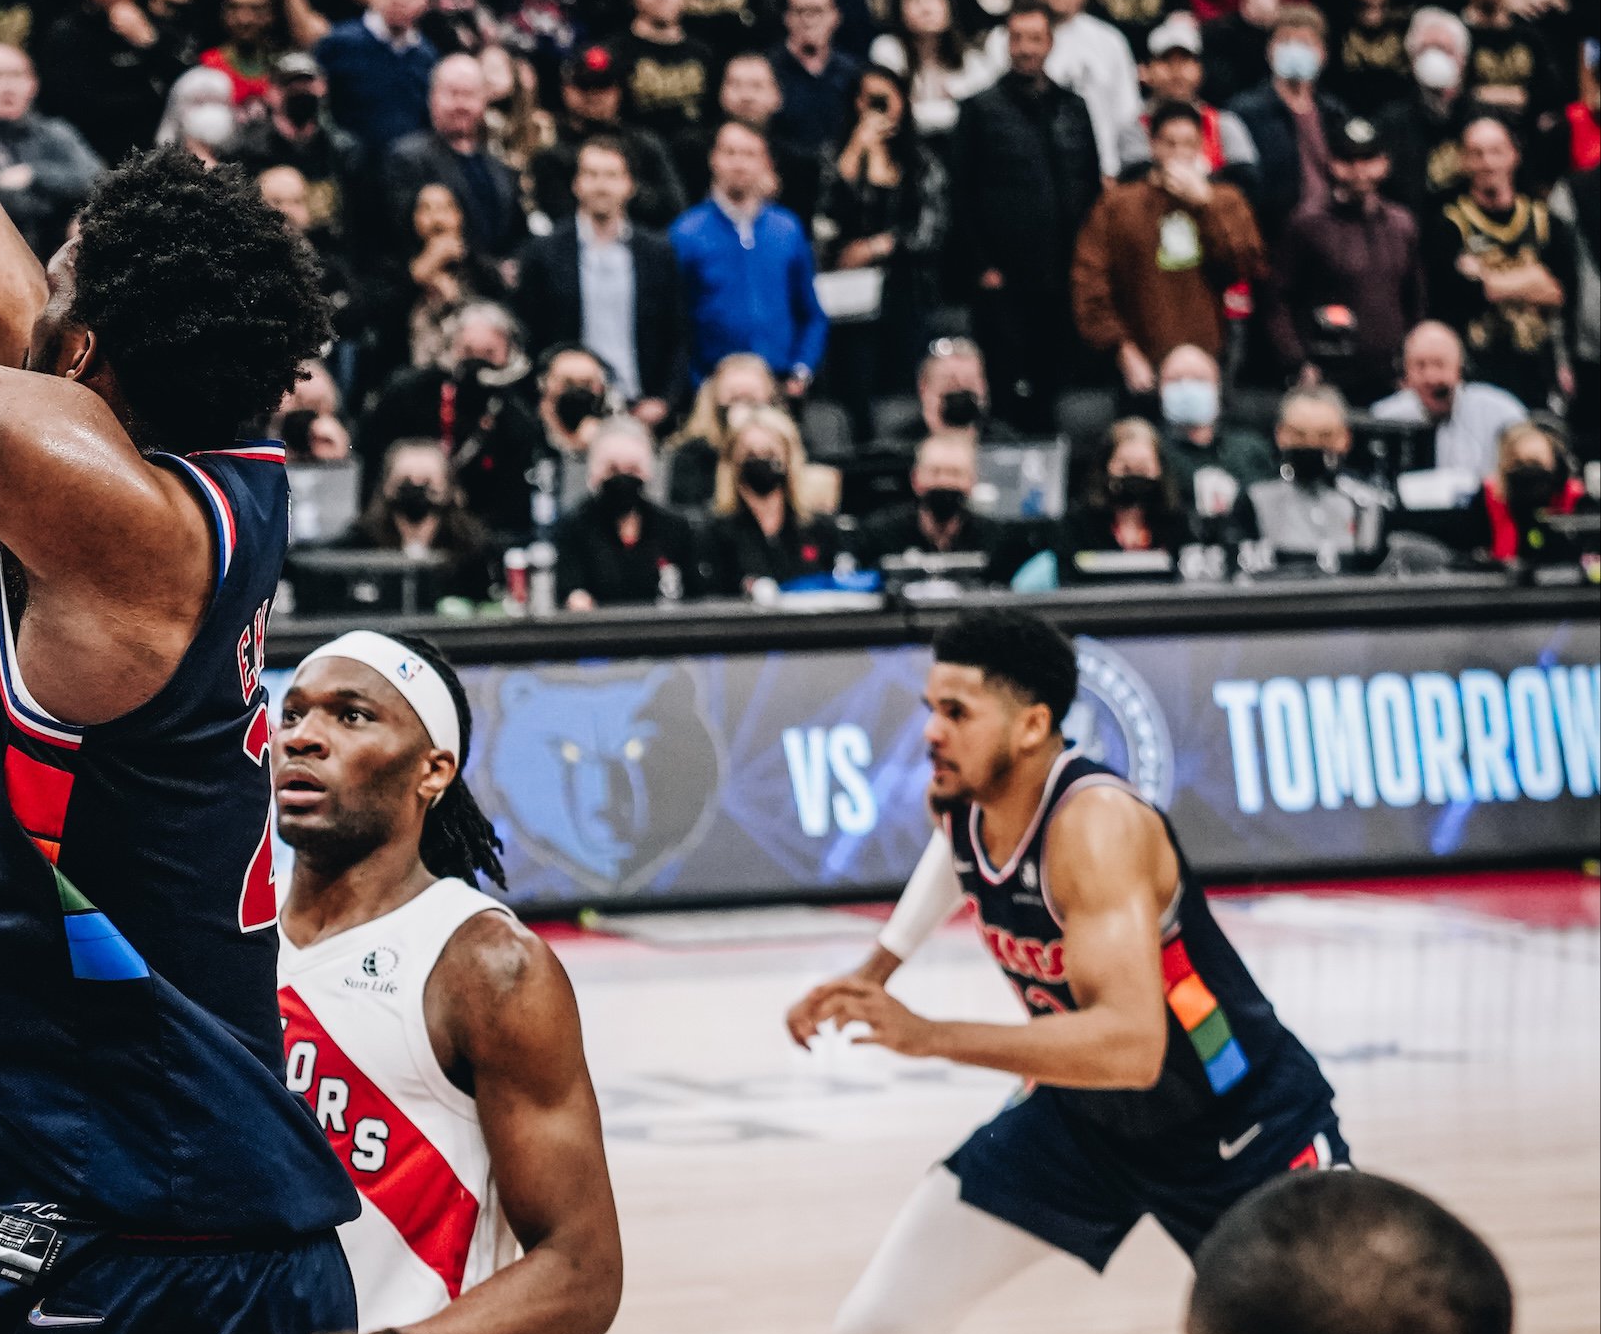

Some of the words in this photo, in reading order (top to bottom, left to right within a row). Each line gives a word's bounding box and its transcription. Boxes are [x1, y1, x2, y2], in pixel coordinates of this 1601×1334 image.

[782, 723, 878, 838] VS
[1212, 665, 1600, 815] TOMORROW
[343, 977, 368, 989] Sun
[370, 980, 398, 995] Life
[280, 1017, 390, 1173] ORS
